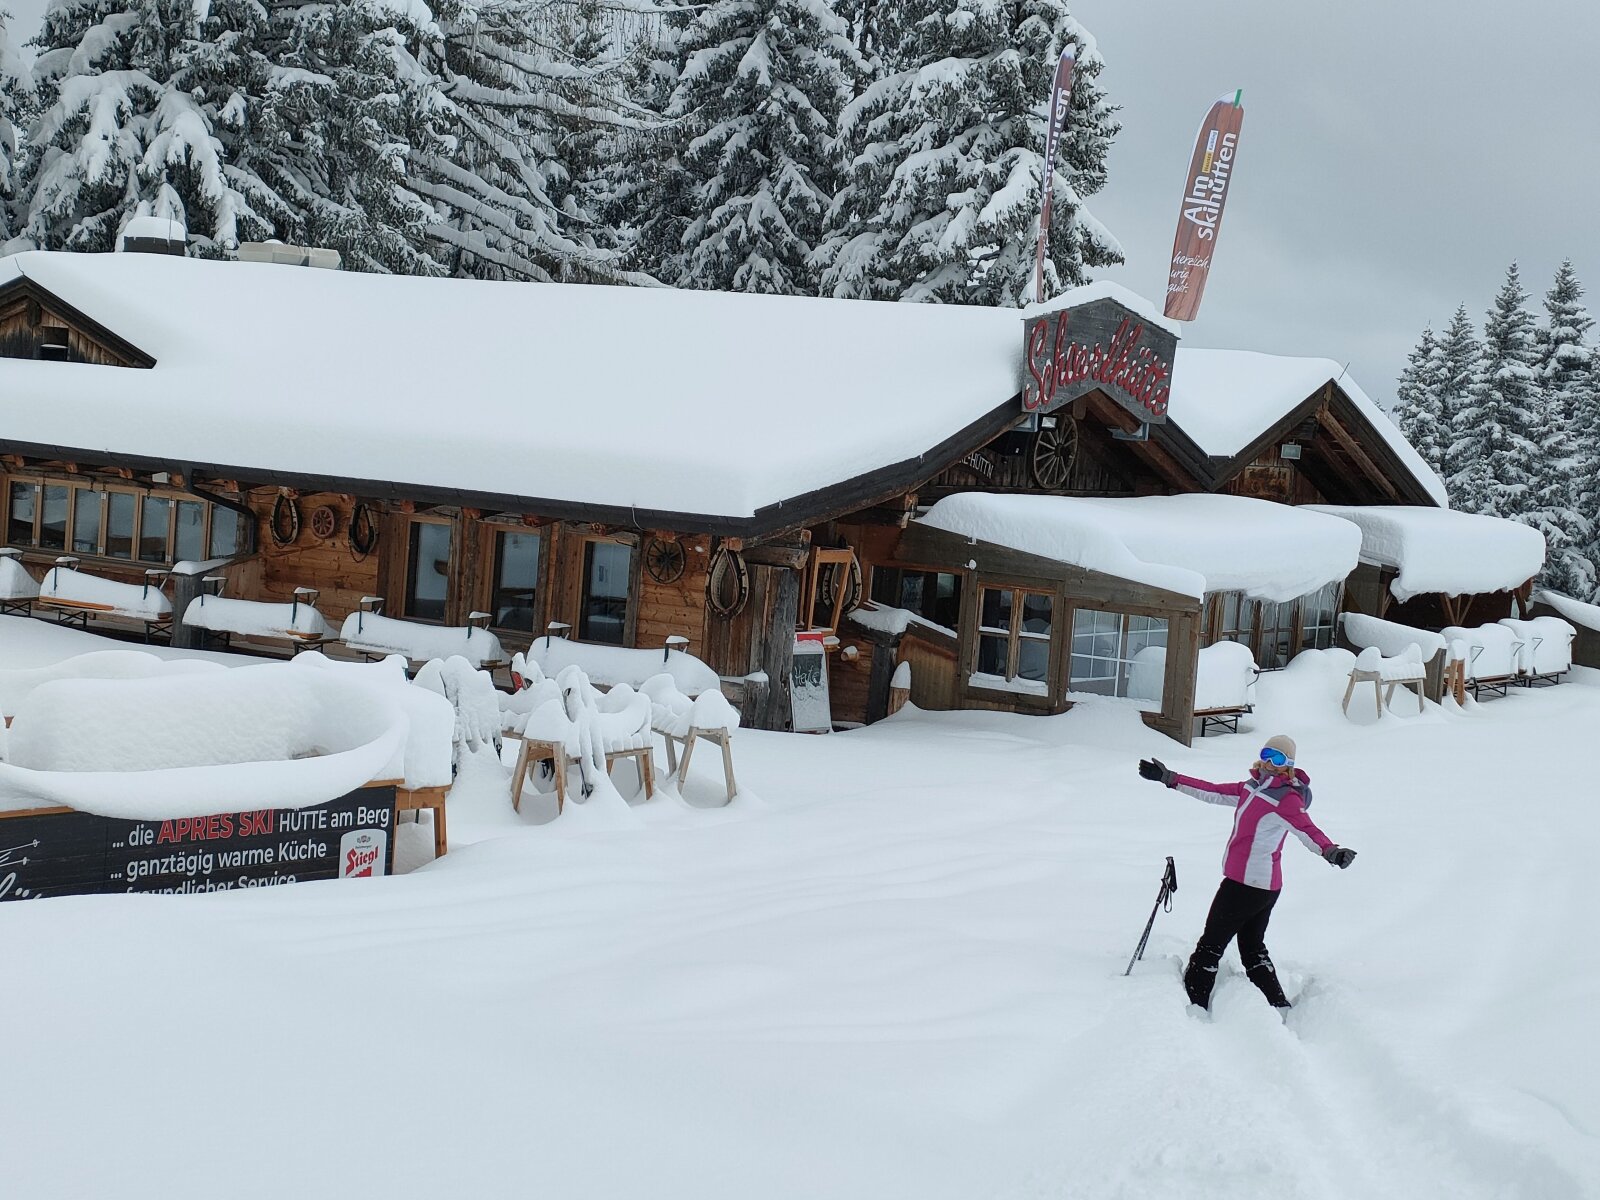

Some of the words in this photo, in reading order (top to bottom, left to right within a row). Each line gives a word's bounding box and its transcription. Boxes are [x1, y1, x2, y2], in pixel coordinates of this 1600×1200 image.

[1184, 175, 1210, 226] Alm
[128, 823, 154, 846] die
[157, 812, 234, 844] APRES
[239, 809, 275, 837] SKI
[279, 809, 327, 833] HÜTTE
[330, 811, 353, 828] am
[357, 806, 390, 828] Berg
[126, 849, 213, 882] ganztägig
[218, 847, 274, 868] warme
[278, 838, 327, 862] Küche
[346, 845, 379, 876] Stiegl
